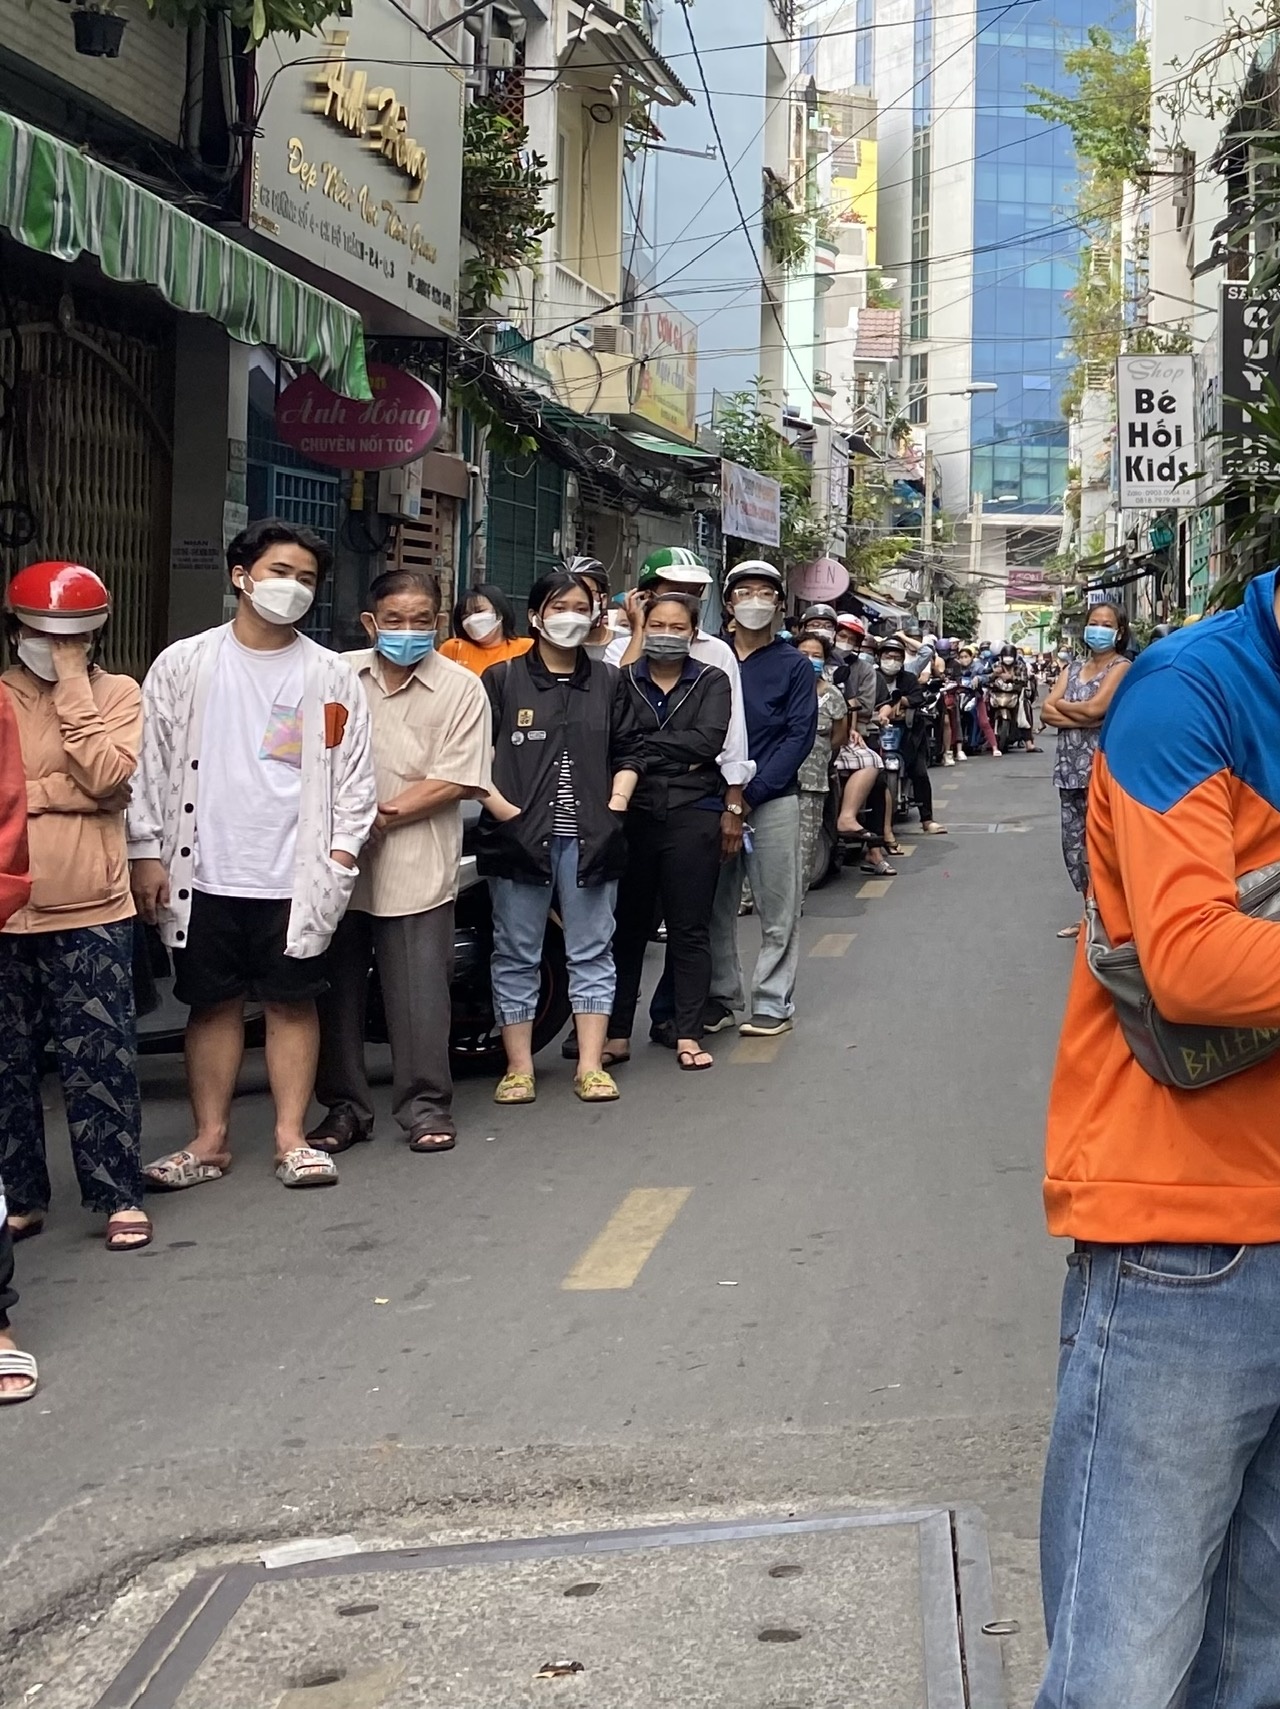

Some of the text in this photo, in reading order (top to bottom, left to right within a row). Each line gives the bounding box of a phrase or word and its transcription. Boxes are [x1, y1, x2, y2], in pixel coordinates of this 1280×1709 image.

[1126, 358, 1184, 383] Shop
[282, 391, 432, 430] Ánh Hồng
[1135, 389, 1177, 414] Bé
[301, 434, 413, 453] CHUYÊN NỐI TÓC
[1128, 418, 1182, 448] Hối
[1125, 455, 1188, 482] Kids
